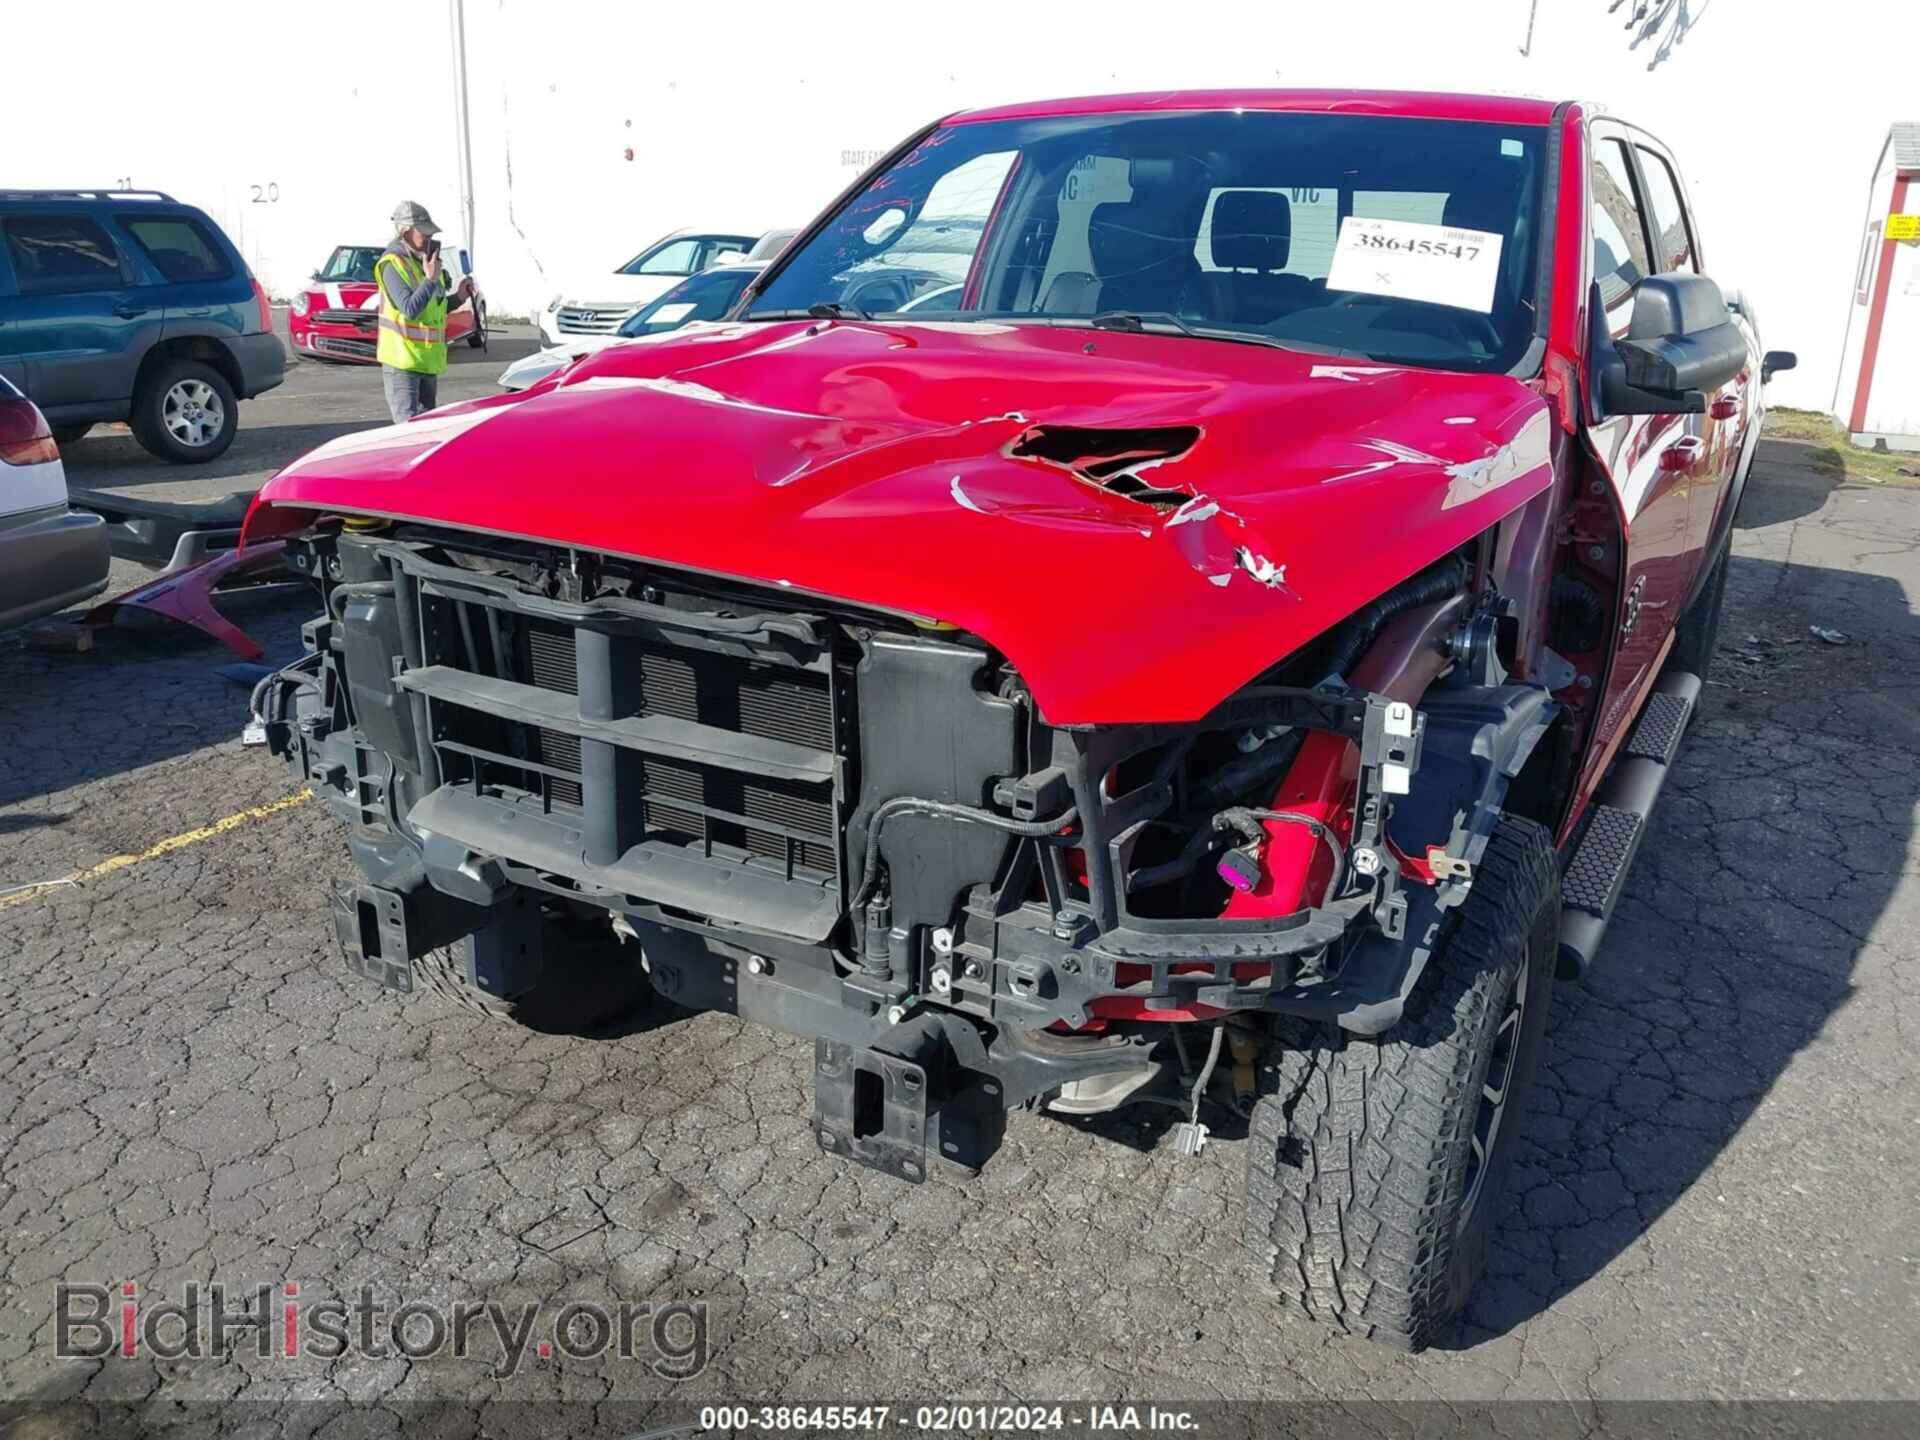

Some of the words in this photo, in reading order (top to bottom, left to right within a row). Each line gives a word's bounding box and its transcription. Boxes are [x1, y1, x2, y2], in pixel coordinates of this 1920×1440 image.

[1073, 155, 1096, 170] ARM
[250, 181, 280, 203] 20
[1062, 174, 1078, 200] IC
[1353, 232, 1480, 262] 38645547
